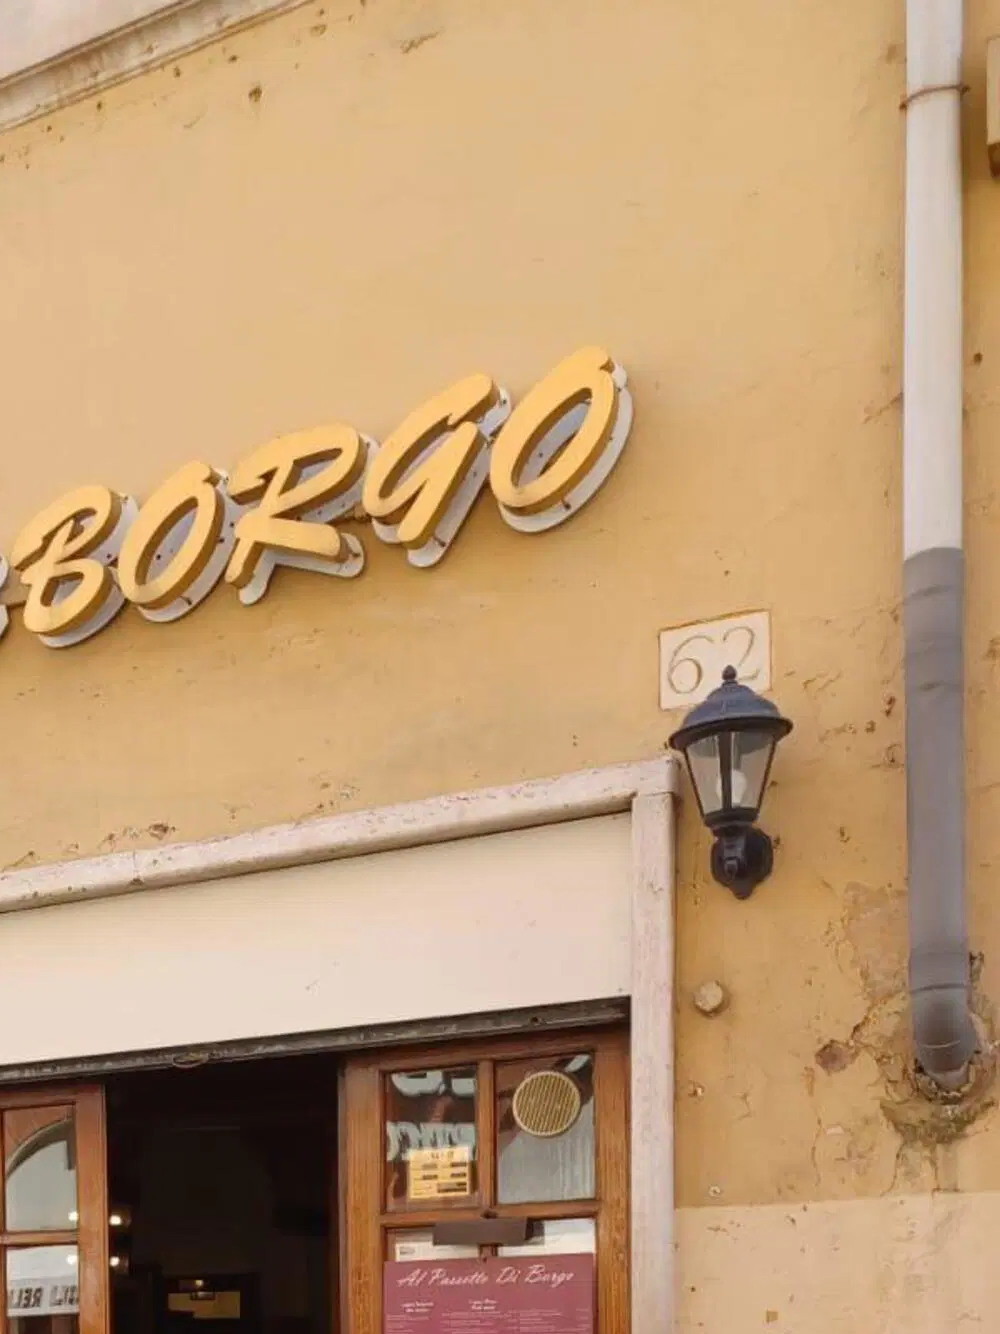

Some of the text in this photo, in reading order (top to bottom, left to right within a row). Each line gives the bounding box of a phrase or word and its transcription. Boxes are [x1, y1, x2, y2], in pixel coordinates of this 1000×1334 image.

[12, 345, 630, 642] BORGO
[667, 626, 761, 694] 62
[397, 1268, 427, 1287] Al
[496, 1266, 521, 1284] Di
[525, 1264, 575, 1288] Borgo
